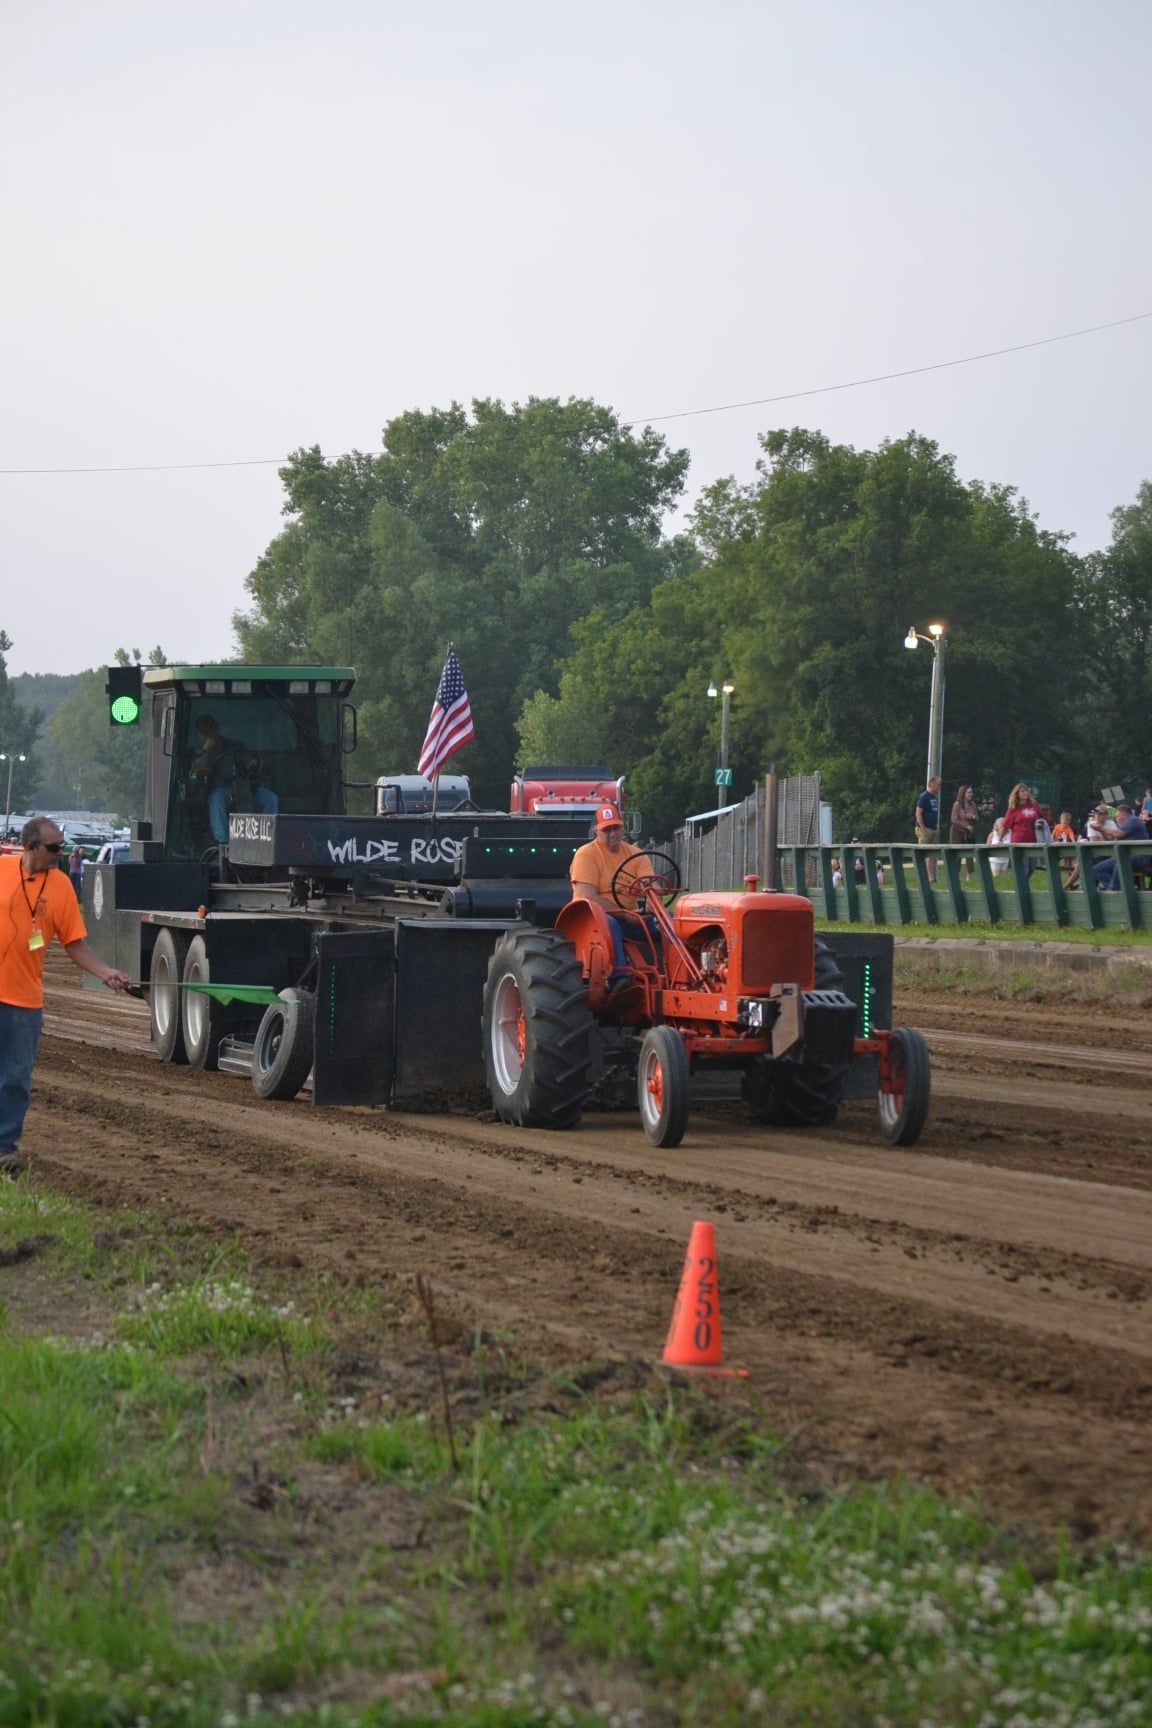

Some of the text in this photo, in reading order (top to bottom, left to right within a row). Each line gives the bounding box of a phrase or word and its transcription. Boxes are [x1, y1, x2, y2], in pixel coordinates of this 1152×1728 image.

[716, 769, 731, 785] 27
[260, 819, 272, 841] LLC
[327, 836, 401, 864] WILDE
[694, 1257, 715, 1351] 250
